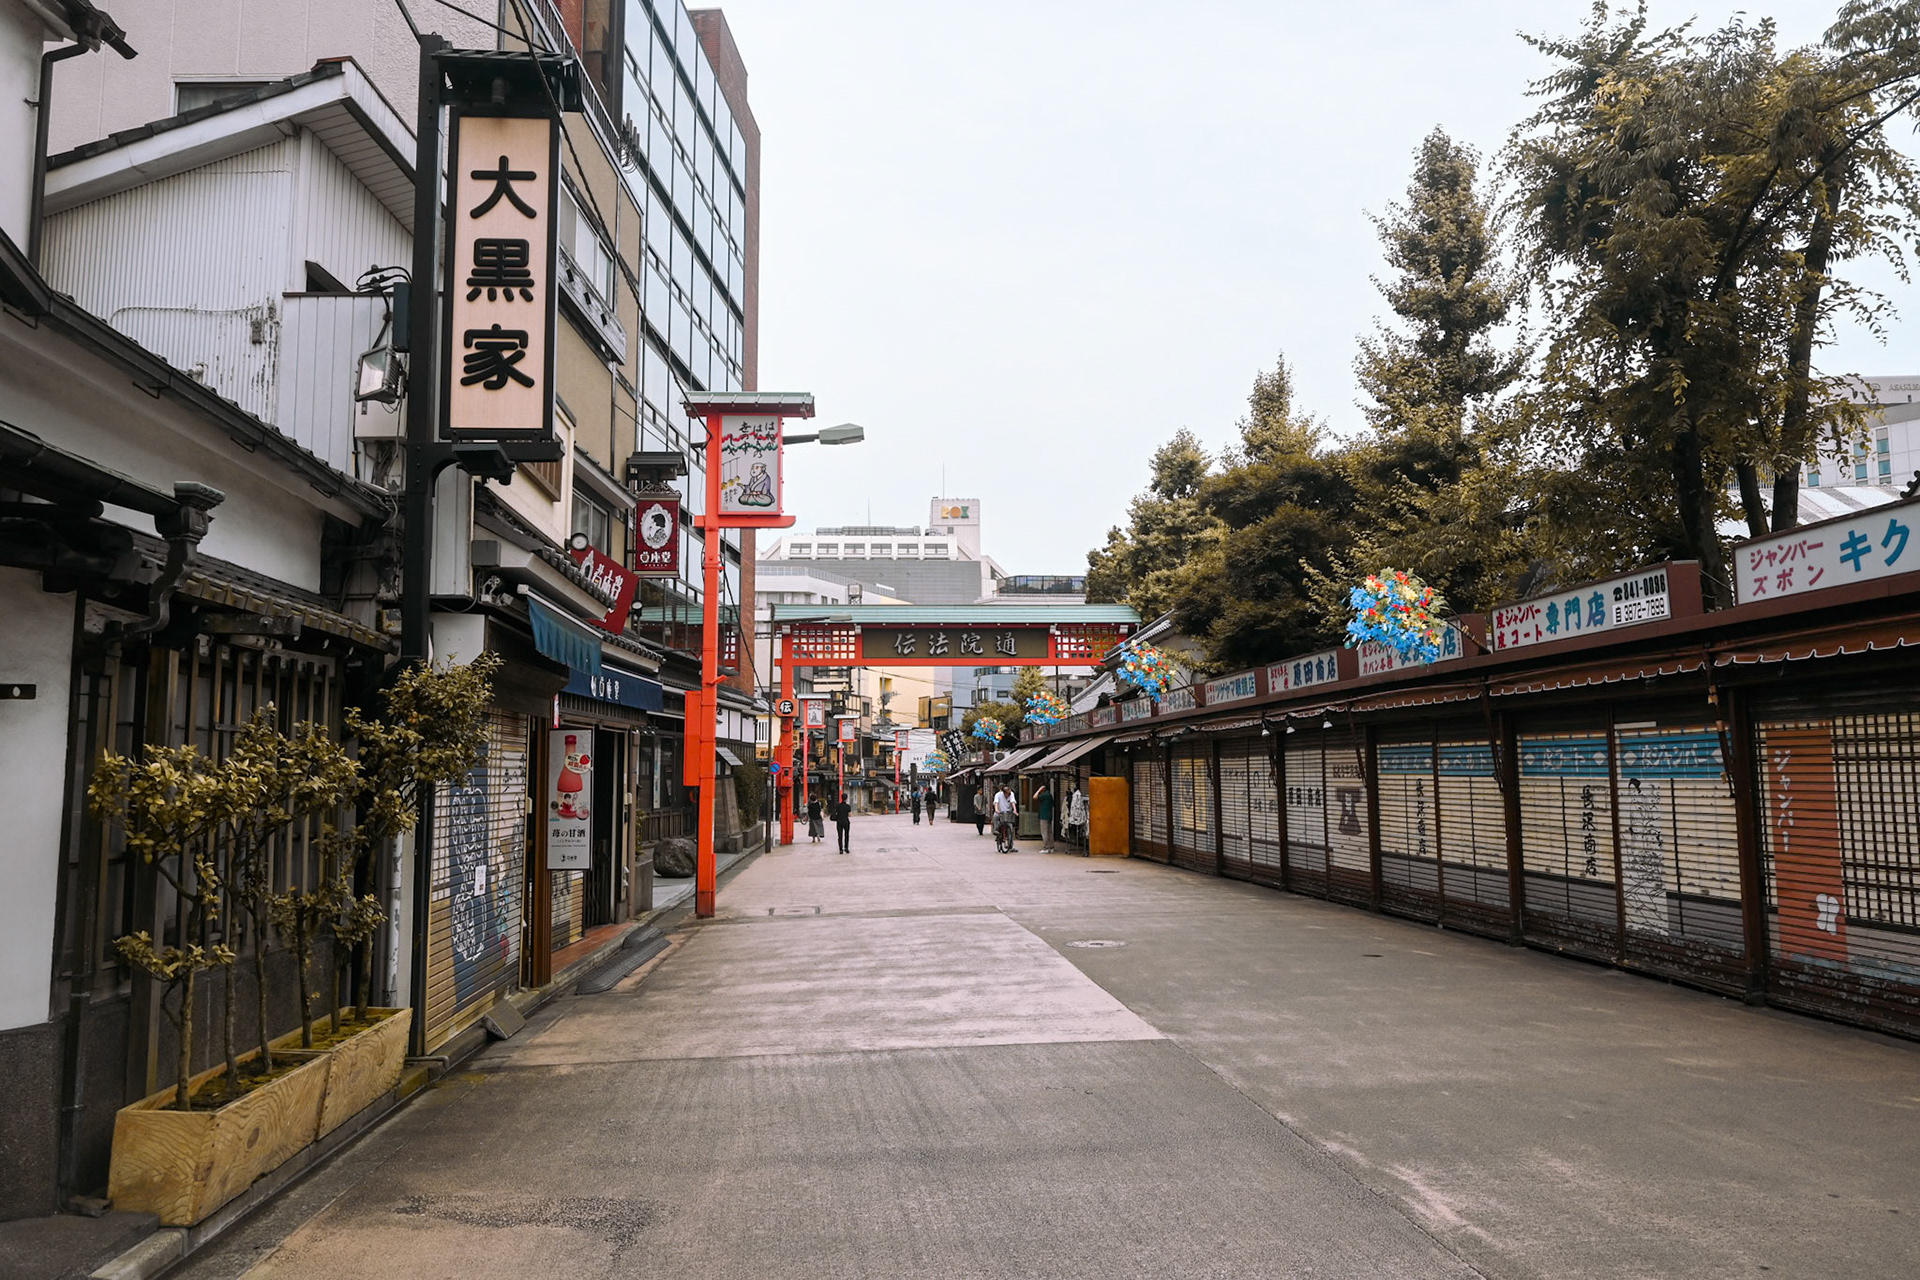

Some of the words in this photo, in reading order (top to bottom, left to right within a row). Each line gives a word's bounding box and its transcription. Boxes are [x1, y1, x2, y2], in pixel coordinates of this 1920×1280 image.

[459, 155, 537, 390] 大黒家
[1888, 383, 1920, 392] ASAKUS
[1750, 539, 1824, 571] ジャンバー
[1839, 518, 1910, 573] キク
[1623, 573, 1667, 601] 841-0096
[1752, 565, 1825, 597] ズボン
[1495, 603, 1542, 630] 皮ジャンバー
[1545, 591, 1607, 635] 専門店
[1624, 597, 1666, 622] 3872-7899
[893, 632, 1018, 656] 伝法院通
[1496, 623, 1543, 650] 皮コート
[1293, 654, 1336, 687] 原田商店
[1773, 749, 1795, 853] ジャンパー
[552, 828, 586, 838] 苺の甘酒
